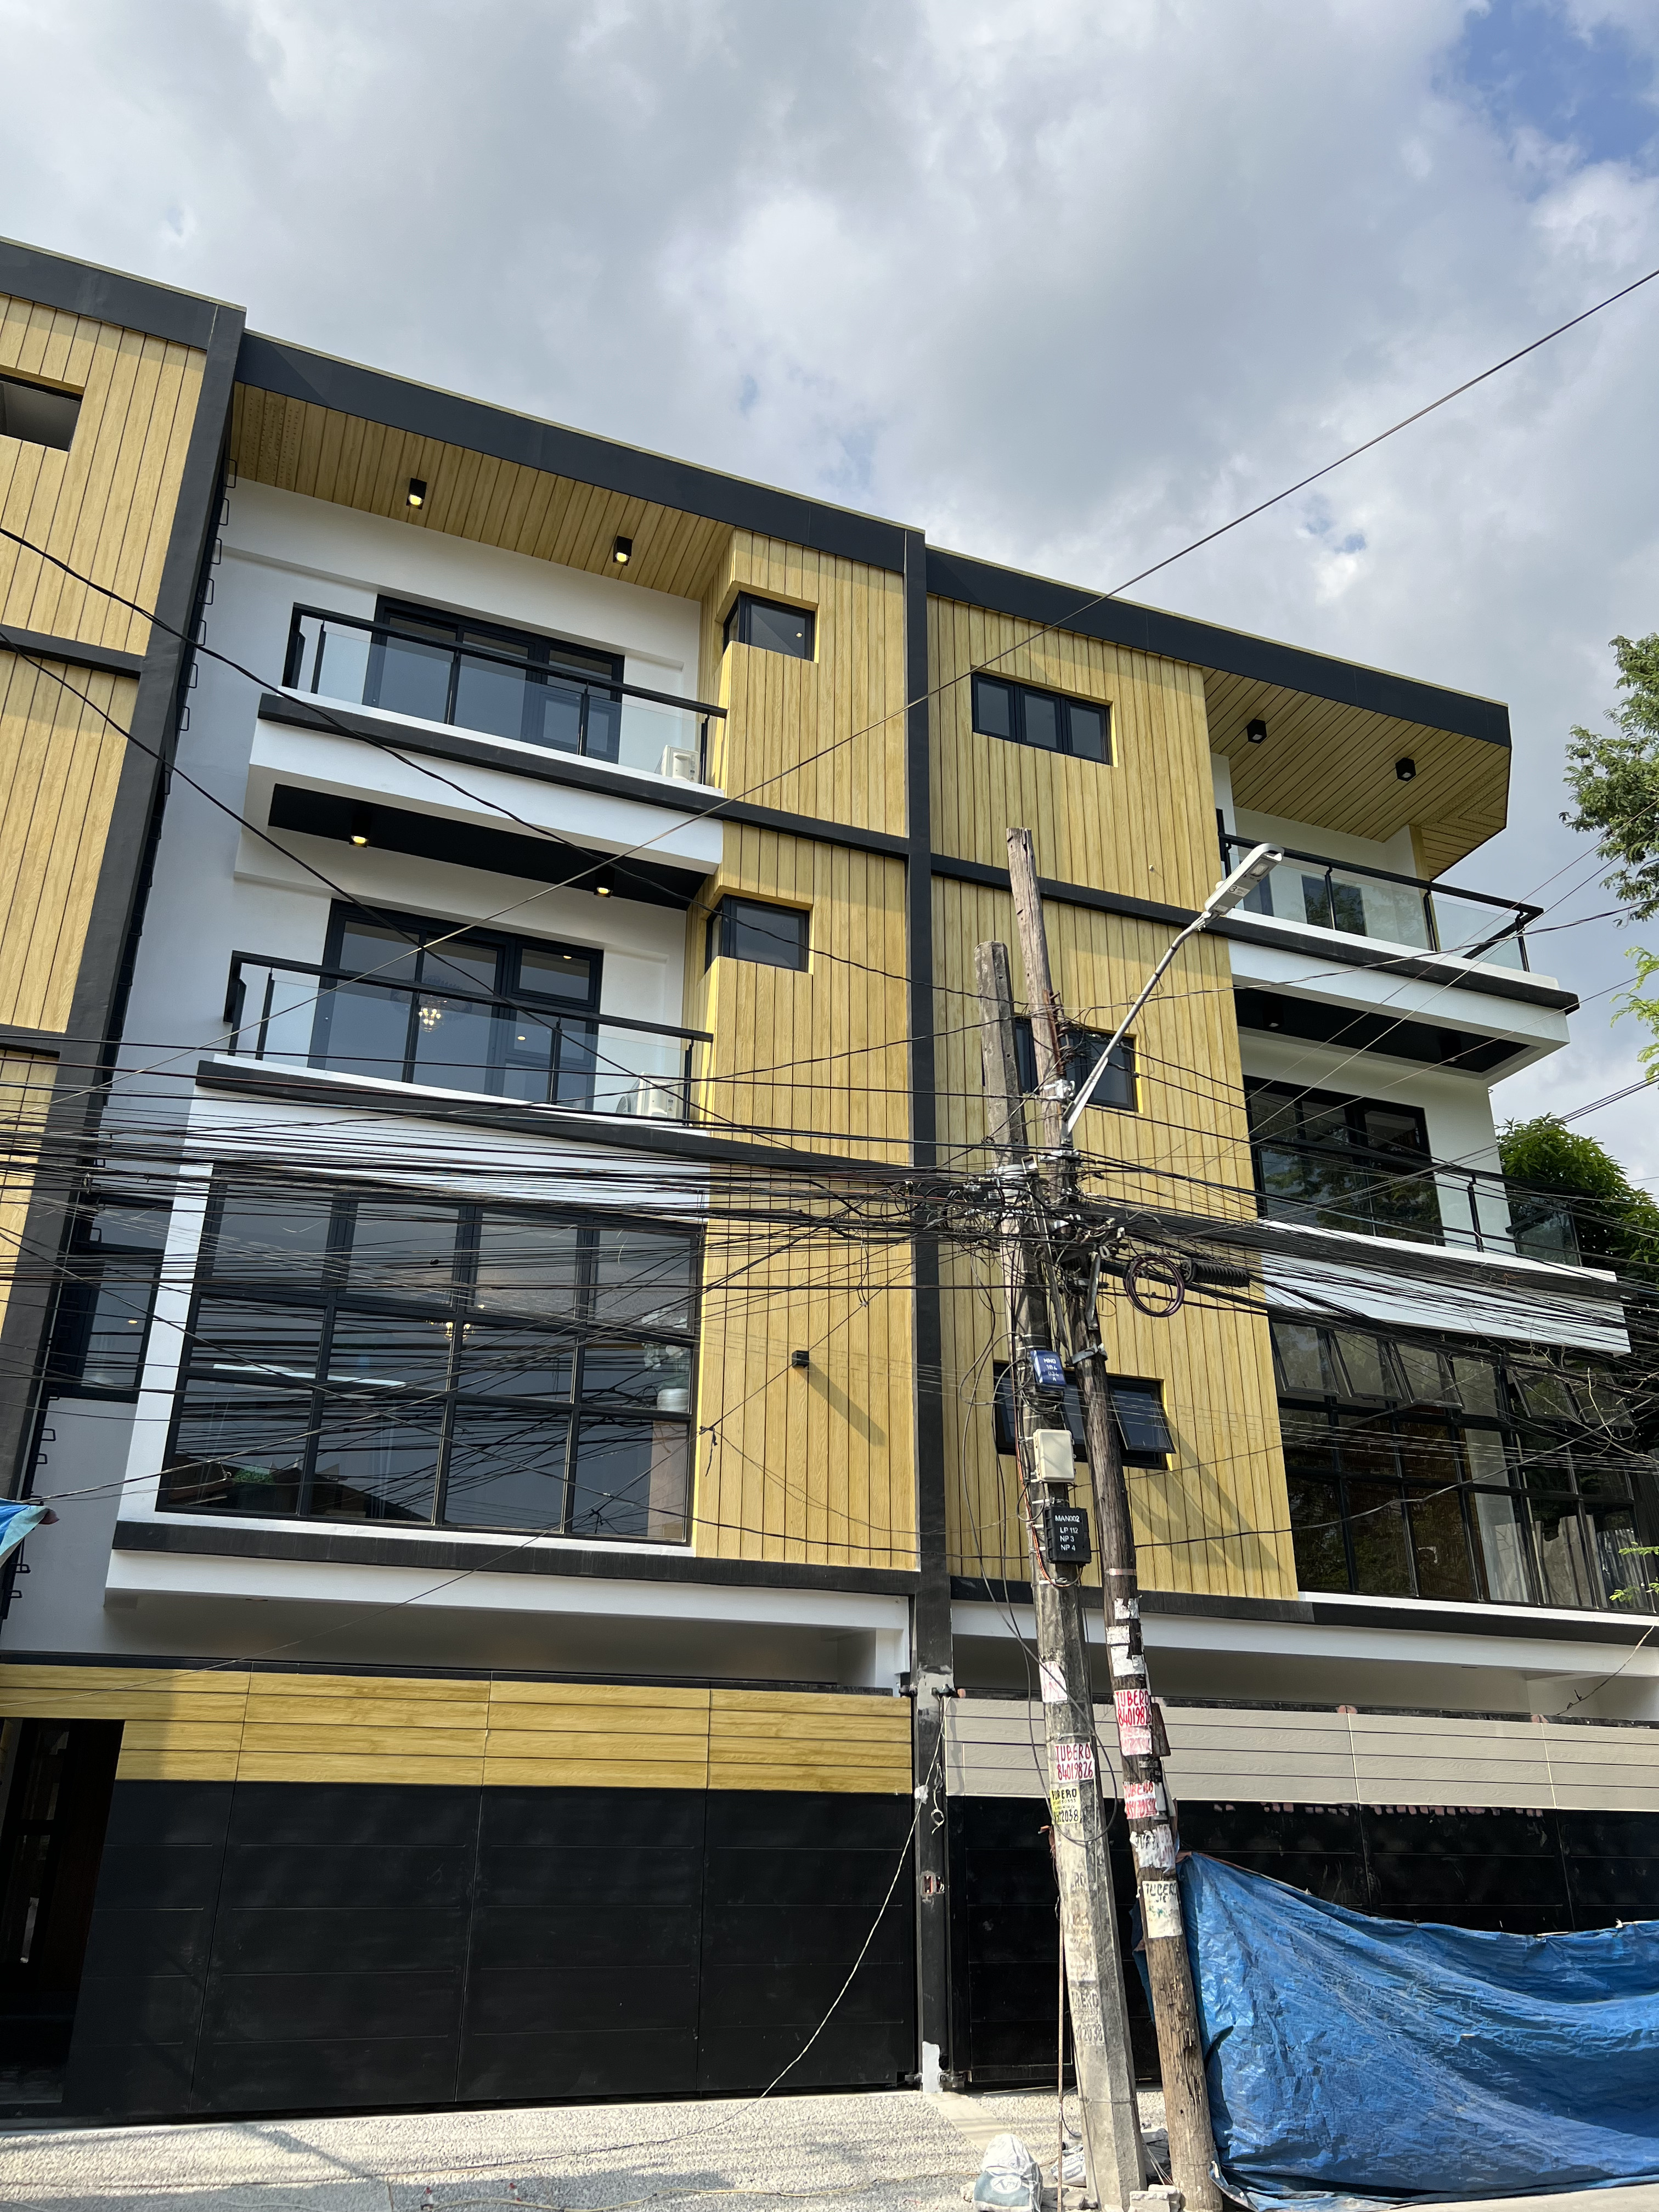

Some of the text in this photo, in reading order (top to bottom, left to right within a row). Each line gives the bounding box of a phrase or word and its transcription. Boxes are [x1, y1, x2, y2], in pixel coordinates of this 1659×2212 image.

[1116, 1690, 1149, 1707] TUBERO
[1056, 1743, 1091, 1763] TUBERO
[1058, 1761, 1093, 1780] 84019826
